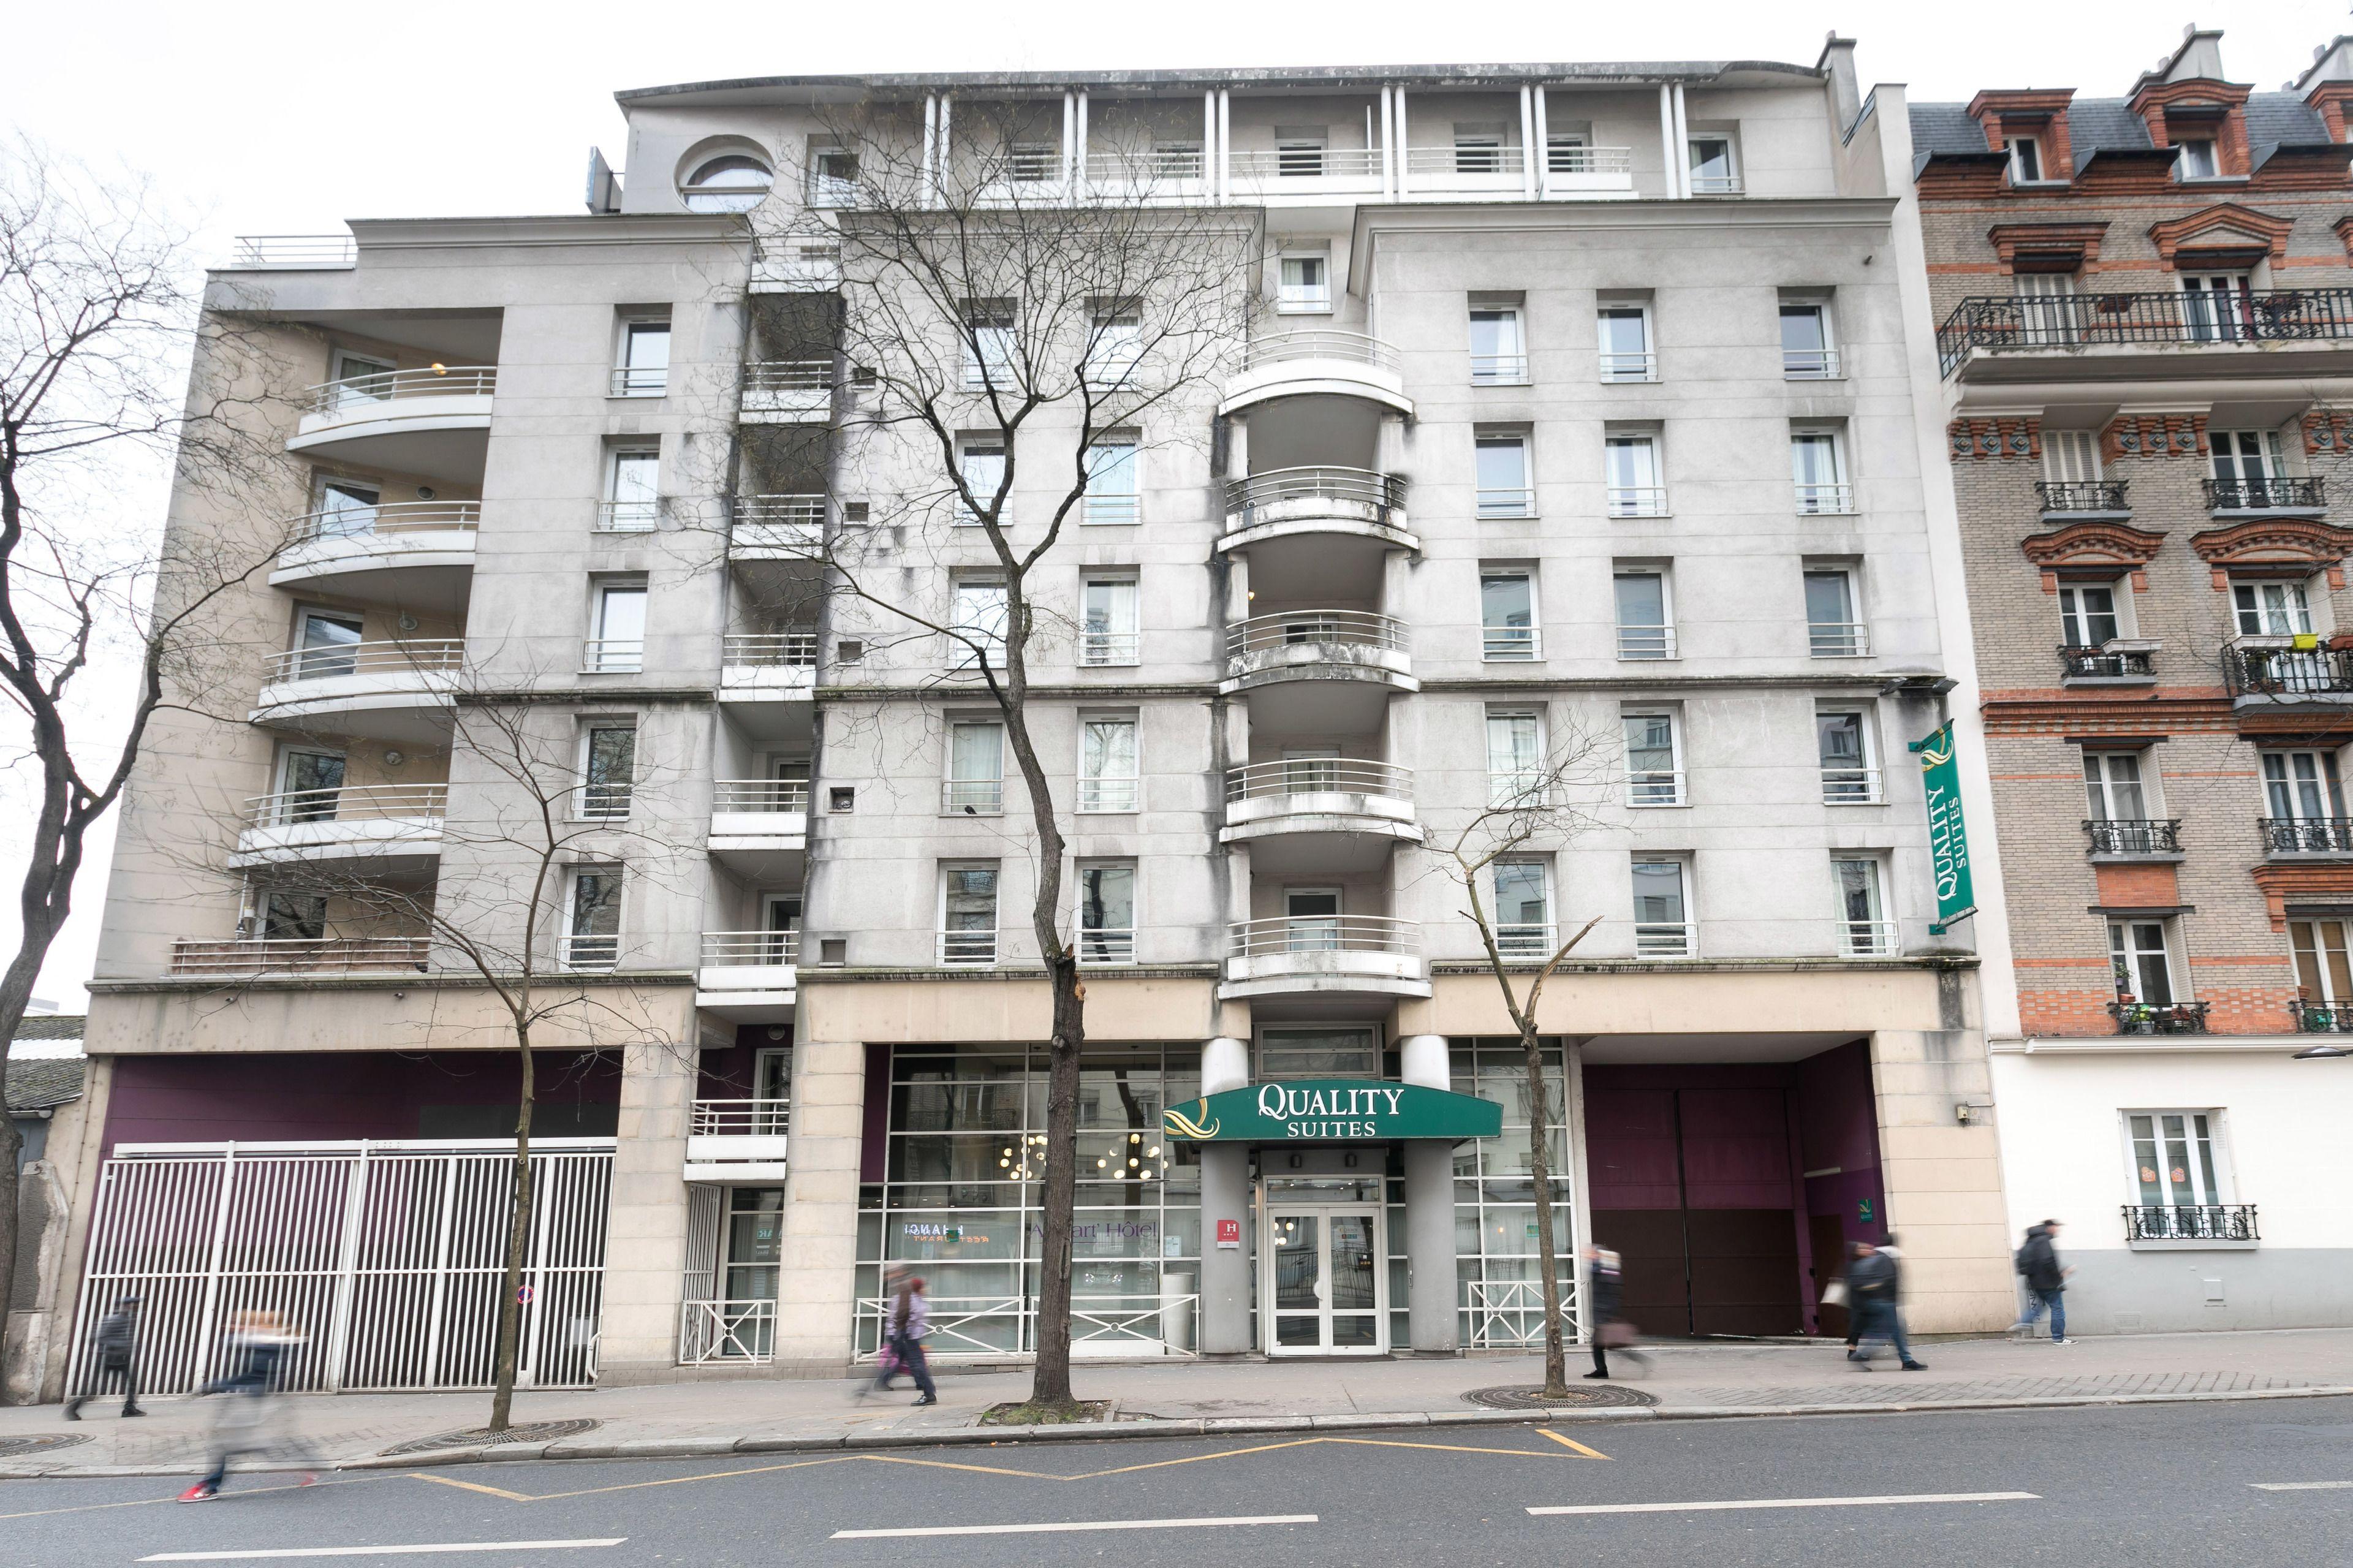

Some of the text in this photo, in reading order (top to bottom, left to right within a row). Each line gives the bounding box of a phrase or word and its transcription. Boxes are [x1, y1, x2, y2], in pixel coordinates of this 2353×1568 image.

[1928, 785, 1958, 901] QUALITY
[1949, 796, 1966, 868] SUITES
[1258, 1084, 1404, 1120] QUALITY
[1287, 1121, 1376, 1137] SUITES
[1030, 1221, 1157, 1238] Aart' Hôtel
[1227, 1224, 1236, 1232] H
